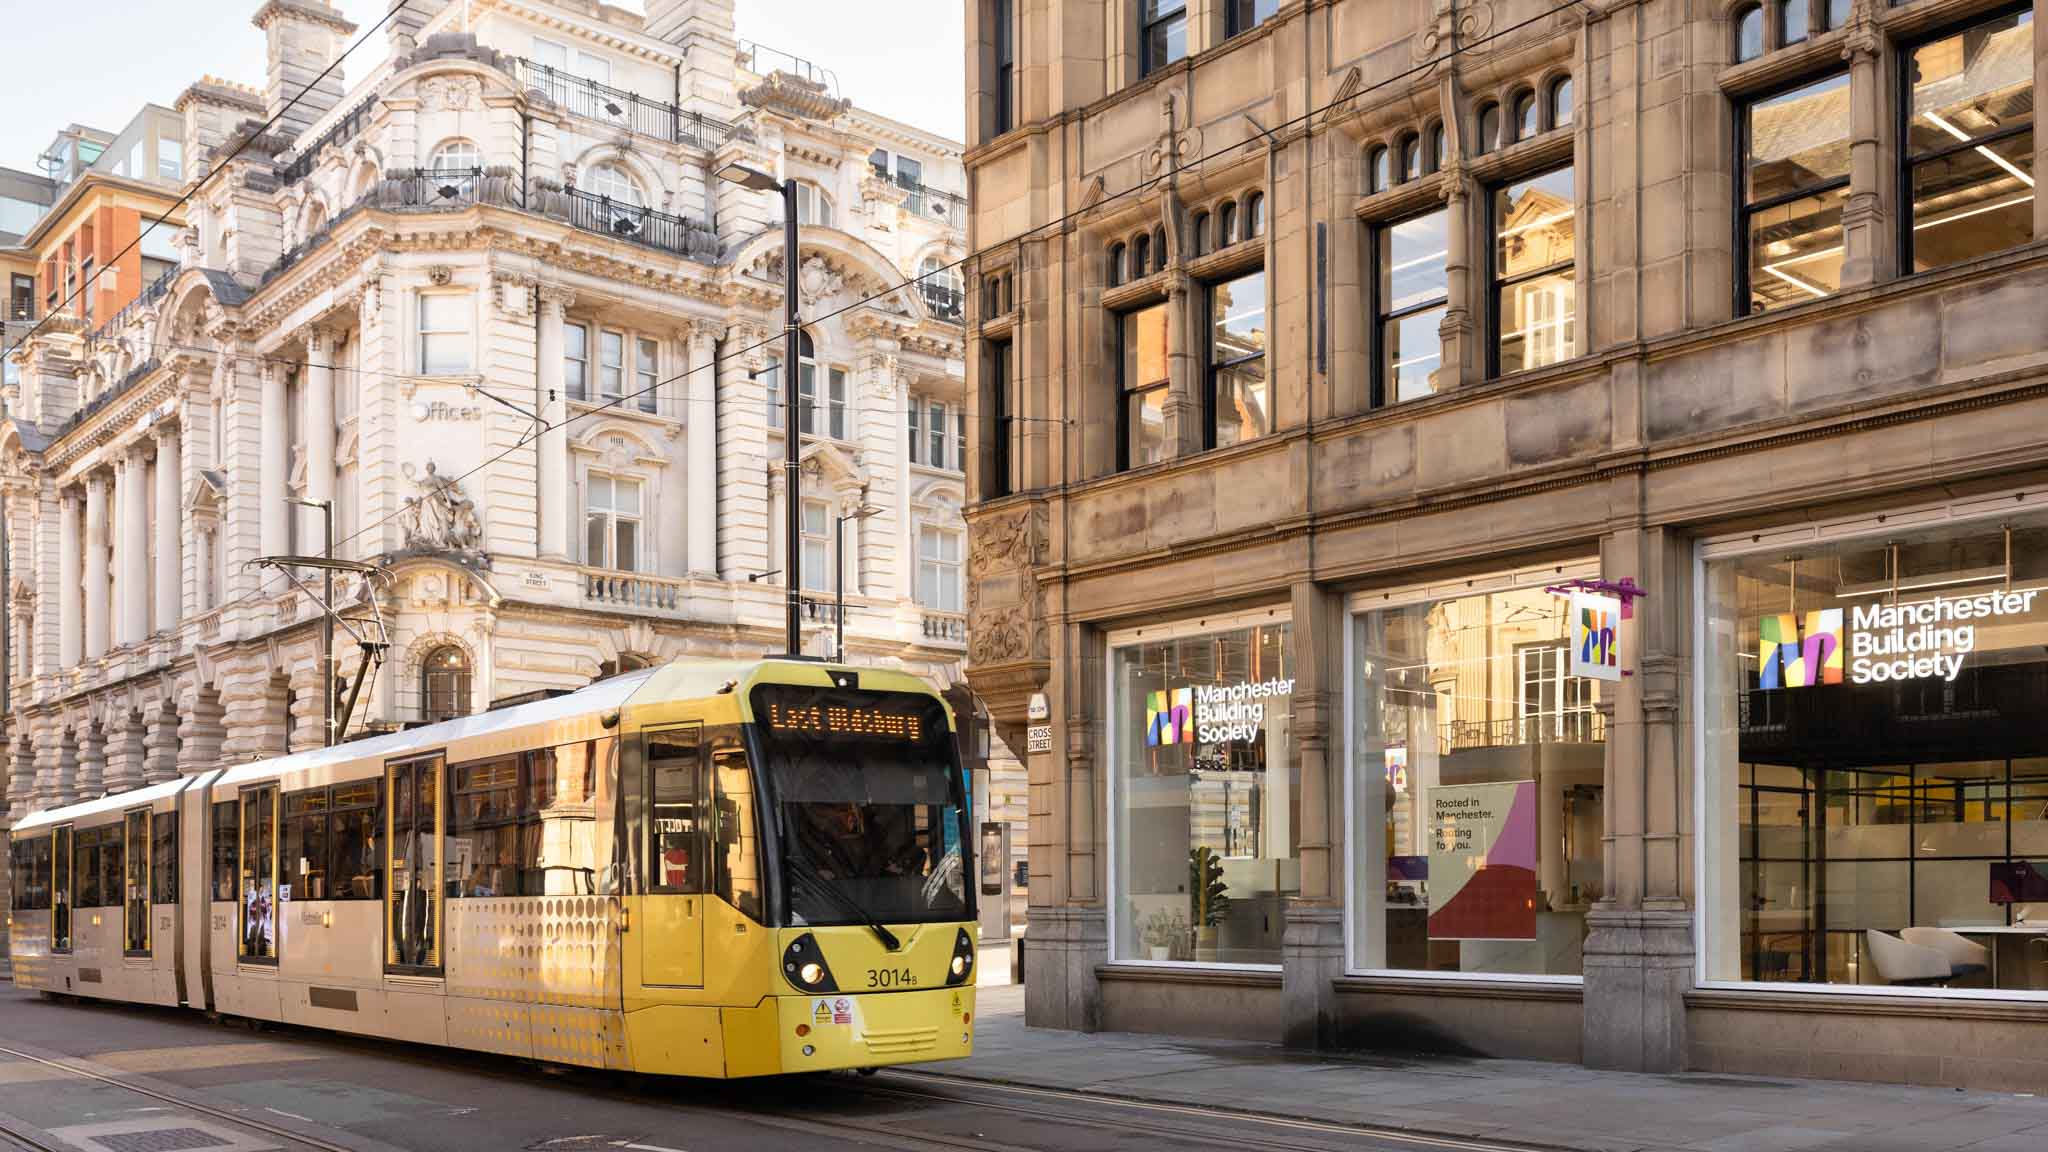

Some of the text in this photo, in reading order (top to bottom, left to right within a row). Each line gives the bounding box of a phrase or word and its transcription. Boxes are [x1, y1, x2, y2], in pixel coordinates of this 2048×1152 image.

[414, 401, 481, 423] Offices
[1853, 590, 2037, 631] Manchester
[1853, 624, 1974, 657] Building
[1853, 654, 1965, 683] Society
[1198, 677, 1295, 704] Manchester
[1198, 703, 1263, 723] Building
[1029, 728, 1051, 738] CROSS
[1198, 722, 1258, 743] Society
[1029, 739, 1051, 749] STREET
[1436, 797, 1479, 808] Rooted in
[1436, 810, 1494, 820] Manchester.
[1436, 841, 1449, 850] fo
